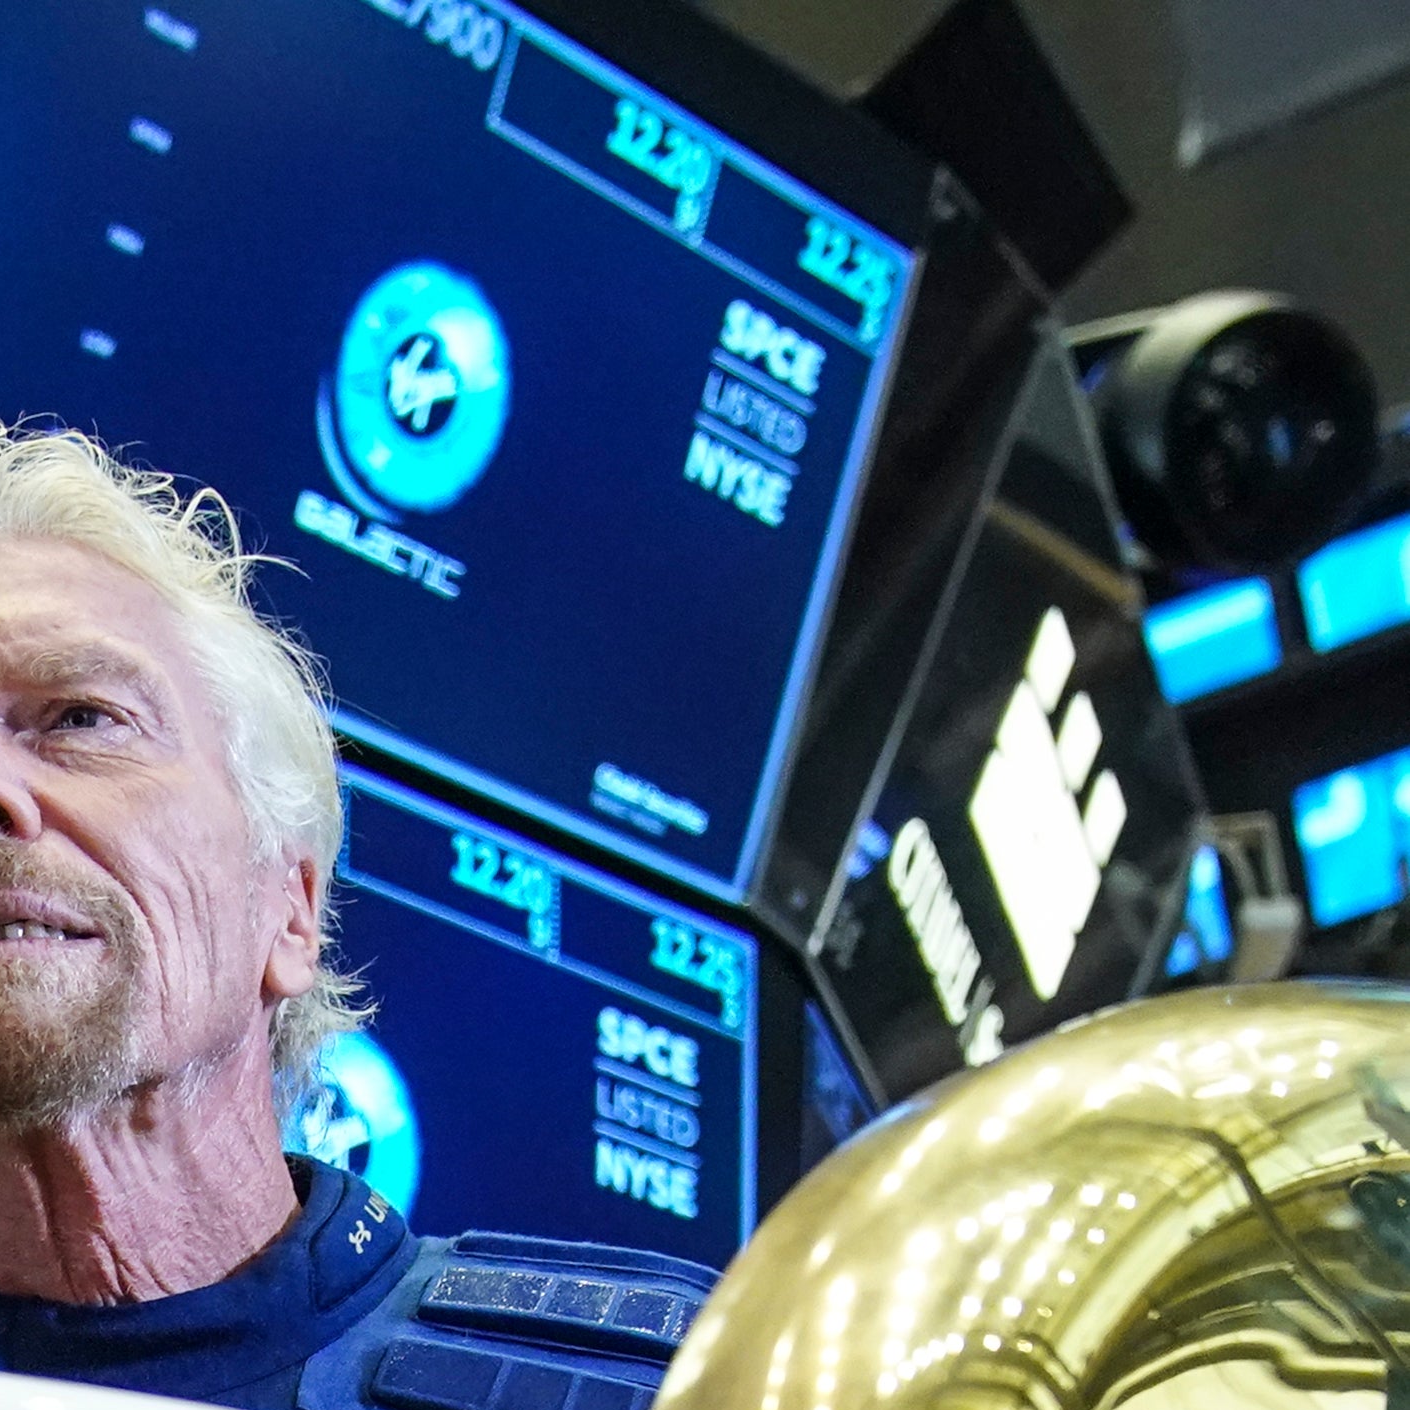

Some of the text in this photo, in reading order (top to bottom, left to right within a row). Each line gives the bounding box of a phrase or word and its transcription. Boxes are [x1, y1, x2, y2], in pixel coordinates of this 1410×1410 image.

[684, 431, 793, 528] NYSE
[596, 1006, 700, 1088] SPCE
[596, 1075, 701, 1148] LISTED
[596, 1138, 699, 1219] NYSE
